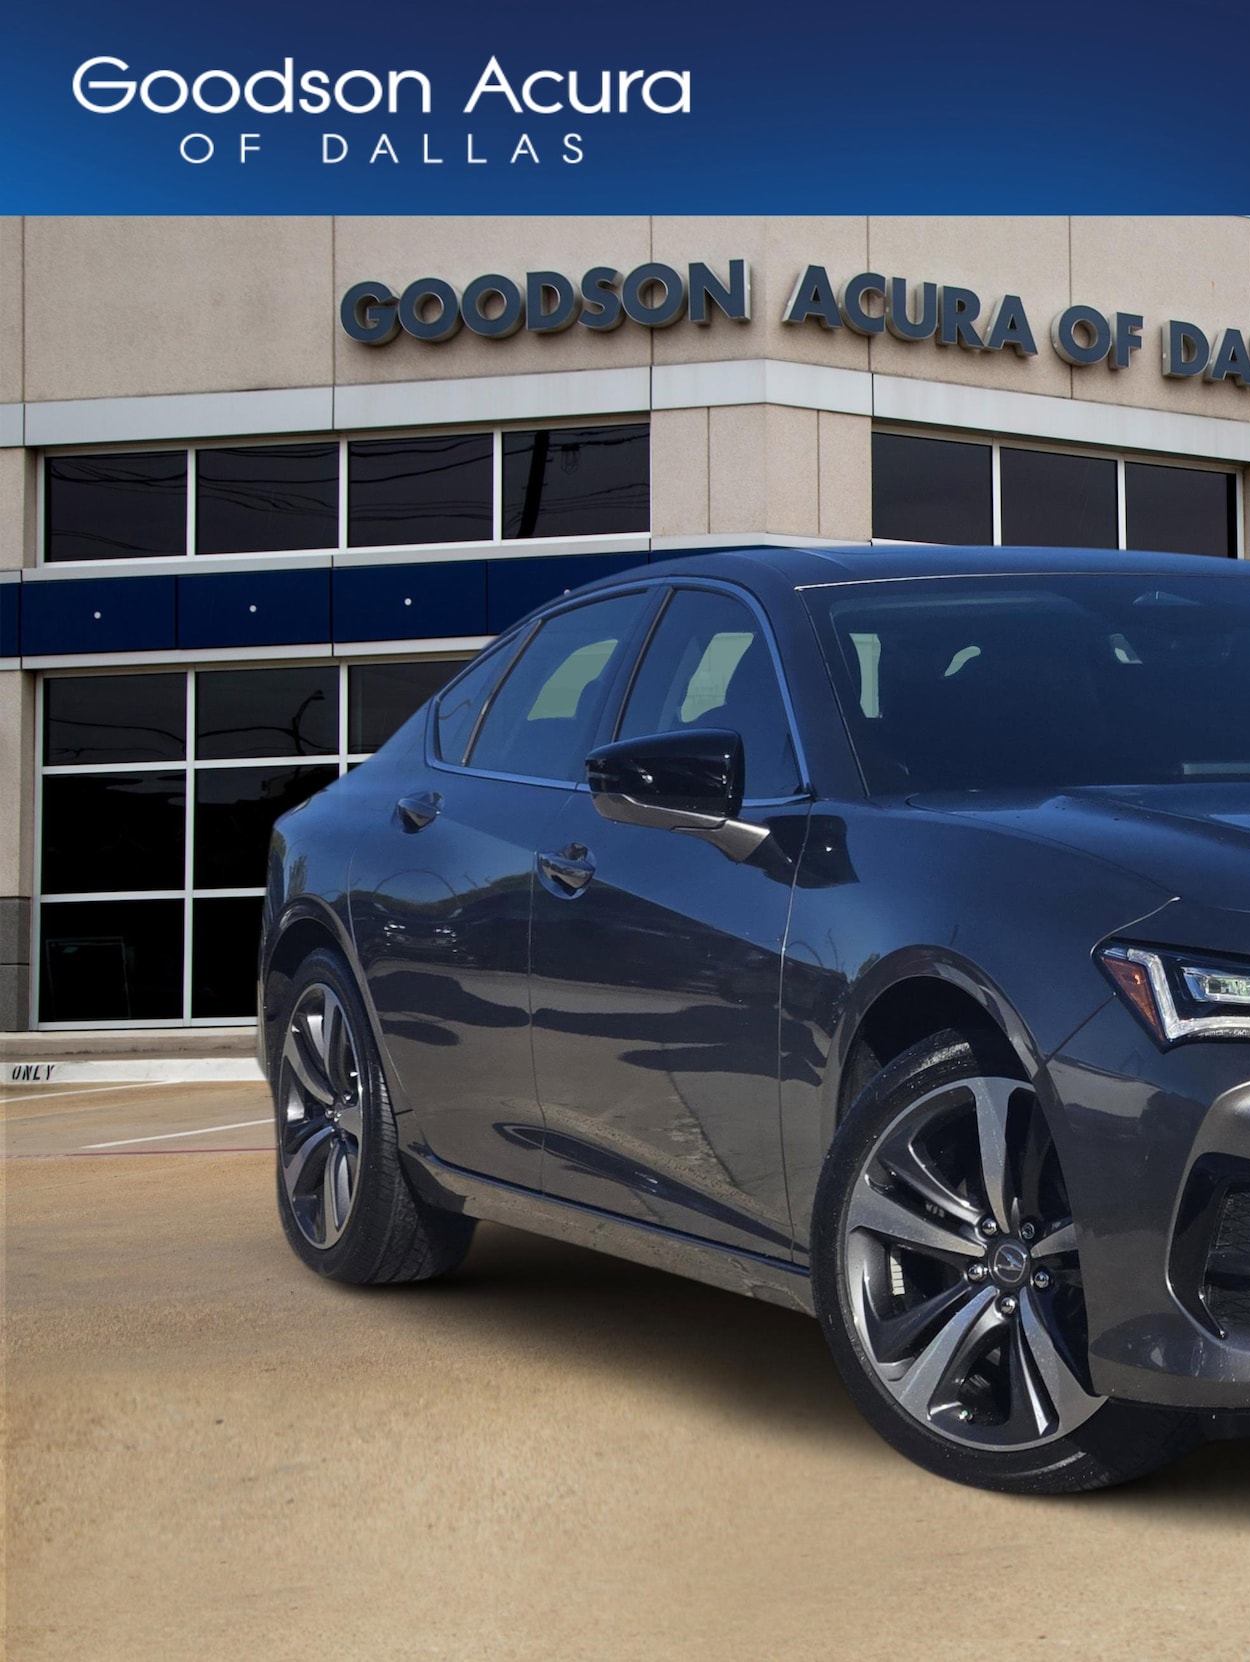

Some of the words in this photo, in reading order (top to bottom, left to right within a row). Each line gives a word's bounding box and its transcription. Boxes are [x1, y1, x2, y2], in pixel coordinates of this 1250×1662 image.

[340, 258, 752, 347] GOODSON
[781, 264, 1039, 358] ACURA
[1051, 304, 1144, 371] OF
[12, 1064, 54, 1081] ONLY
